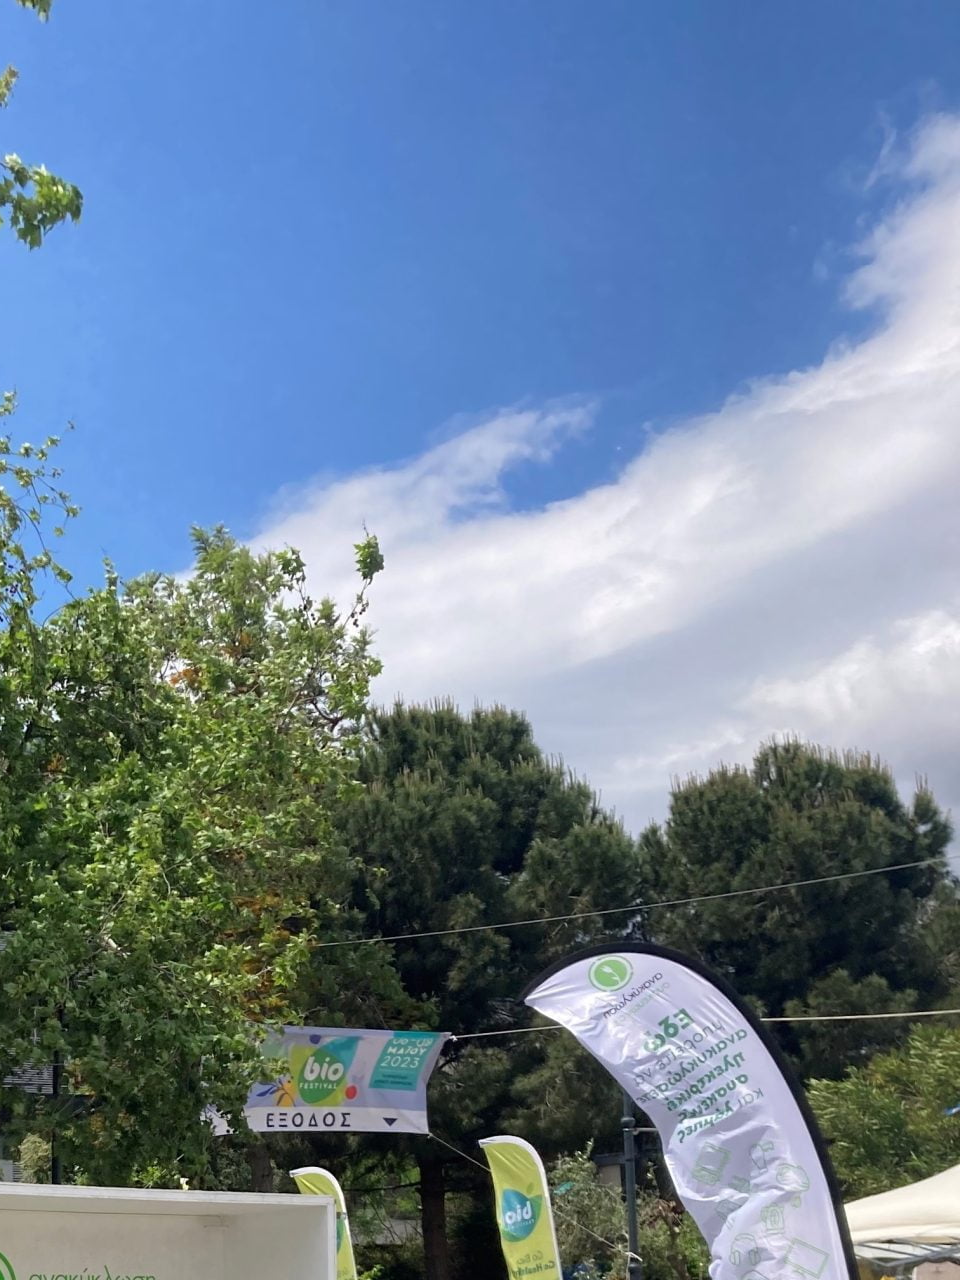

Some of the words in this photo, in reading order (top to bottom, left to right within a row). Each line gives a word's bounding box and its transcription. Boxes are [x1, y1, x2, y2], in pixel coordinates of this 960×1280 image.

[380, 1055, 420, 1068] 2023
[303, 1056, 344, 1082] bio
[299, 1082, 339, 1090] FESTIVAL
[266, 1112, 351, 1128] ΕΞΟΔΟΣ
